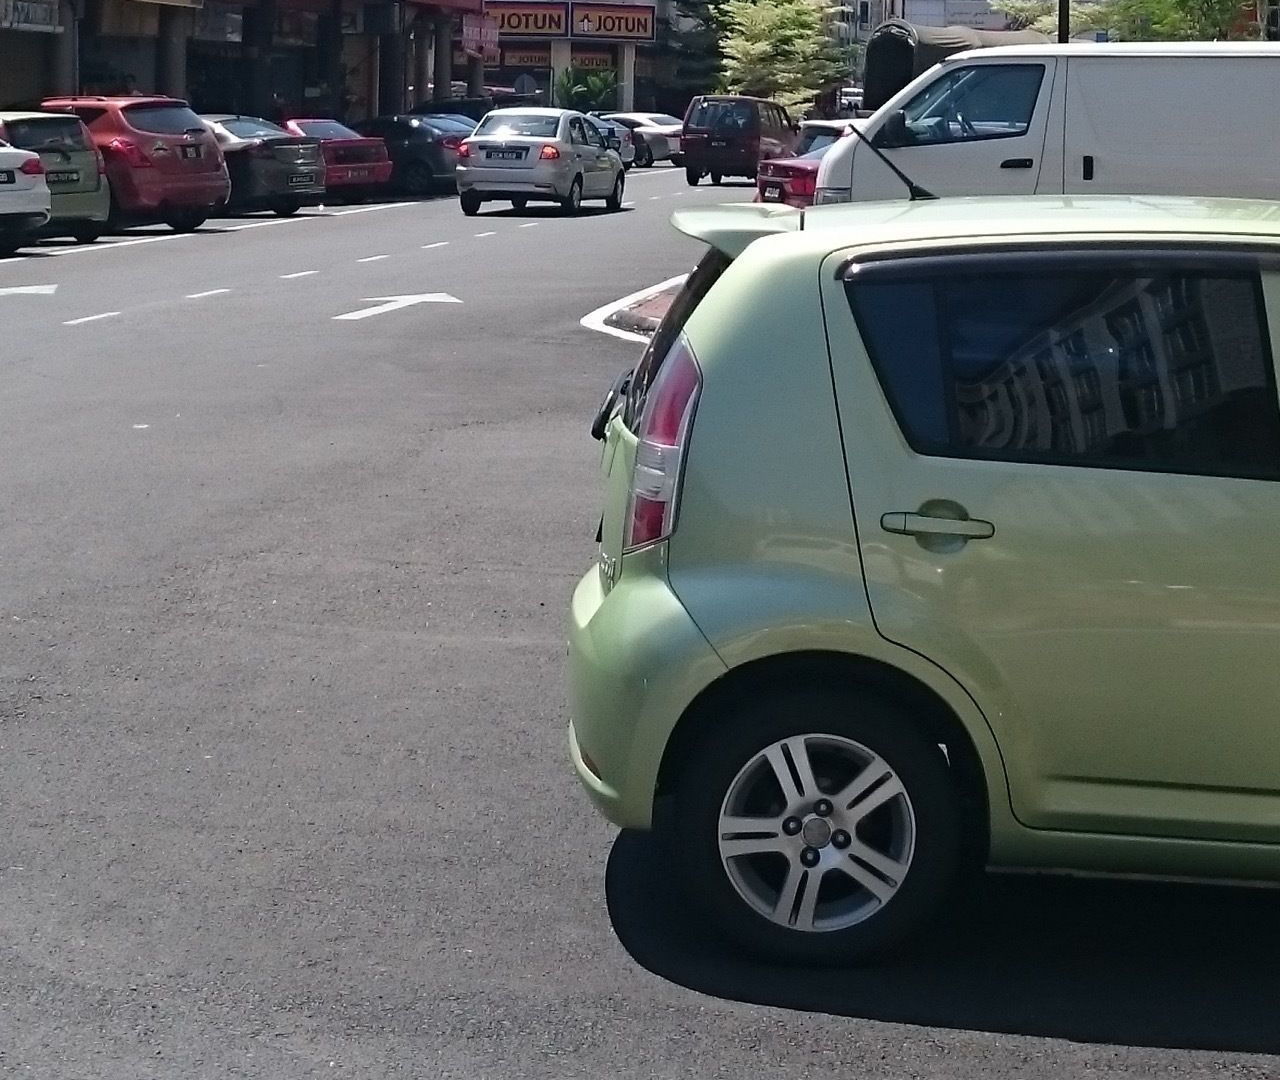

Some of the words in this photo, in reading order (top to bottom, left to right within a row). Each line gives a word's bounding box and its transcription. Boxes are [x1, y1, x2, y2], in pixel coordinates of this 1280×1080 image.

[499, 13, 562, 31] JOTUN
[596, 16, 648, 33] JOTUN
[518, 55, 548, 65] JOTUN
[579, 57, 609, 68] JOTUN
